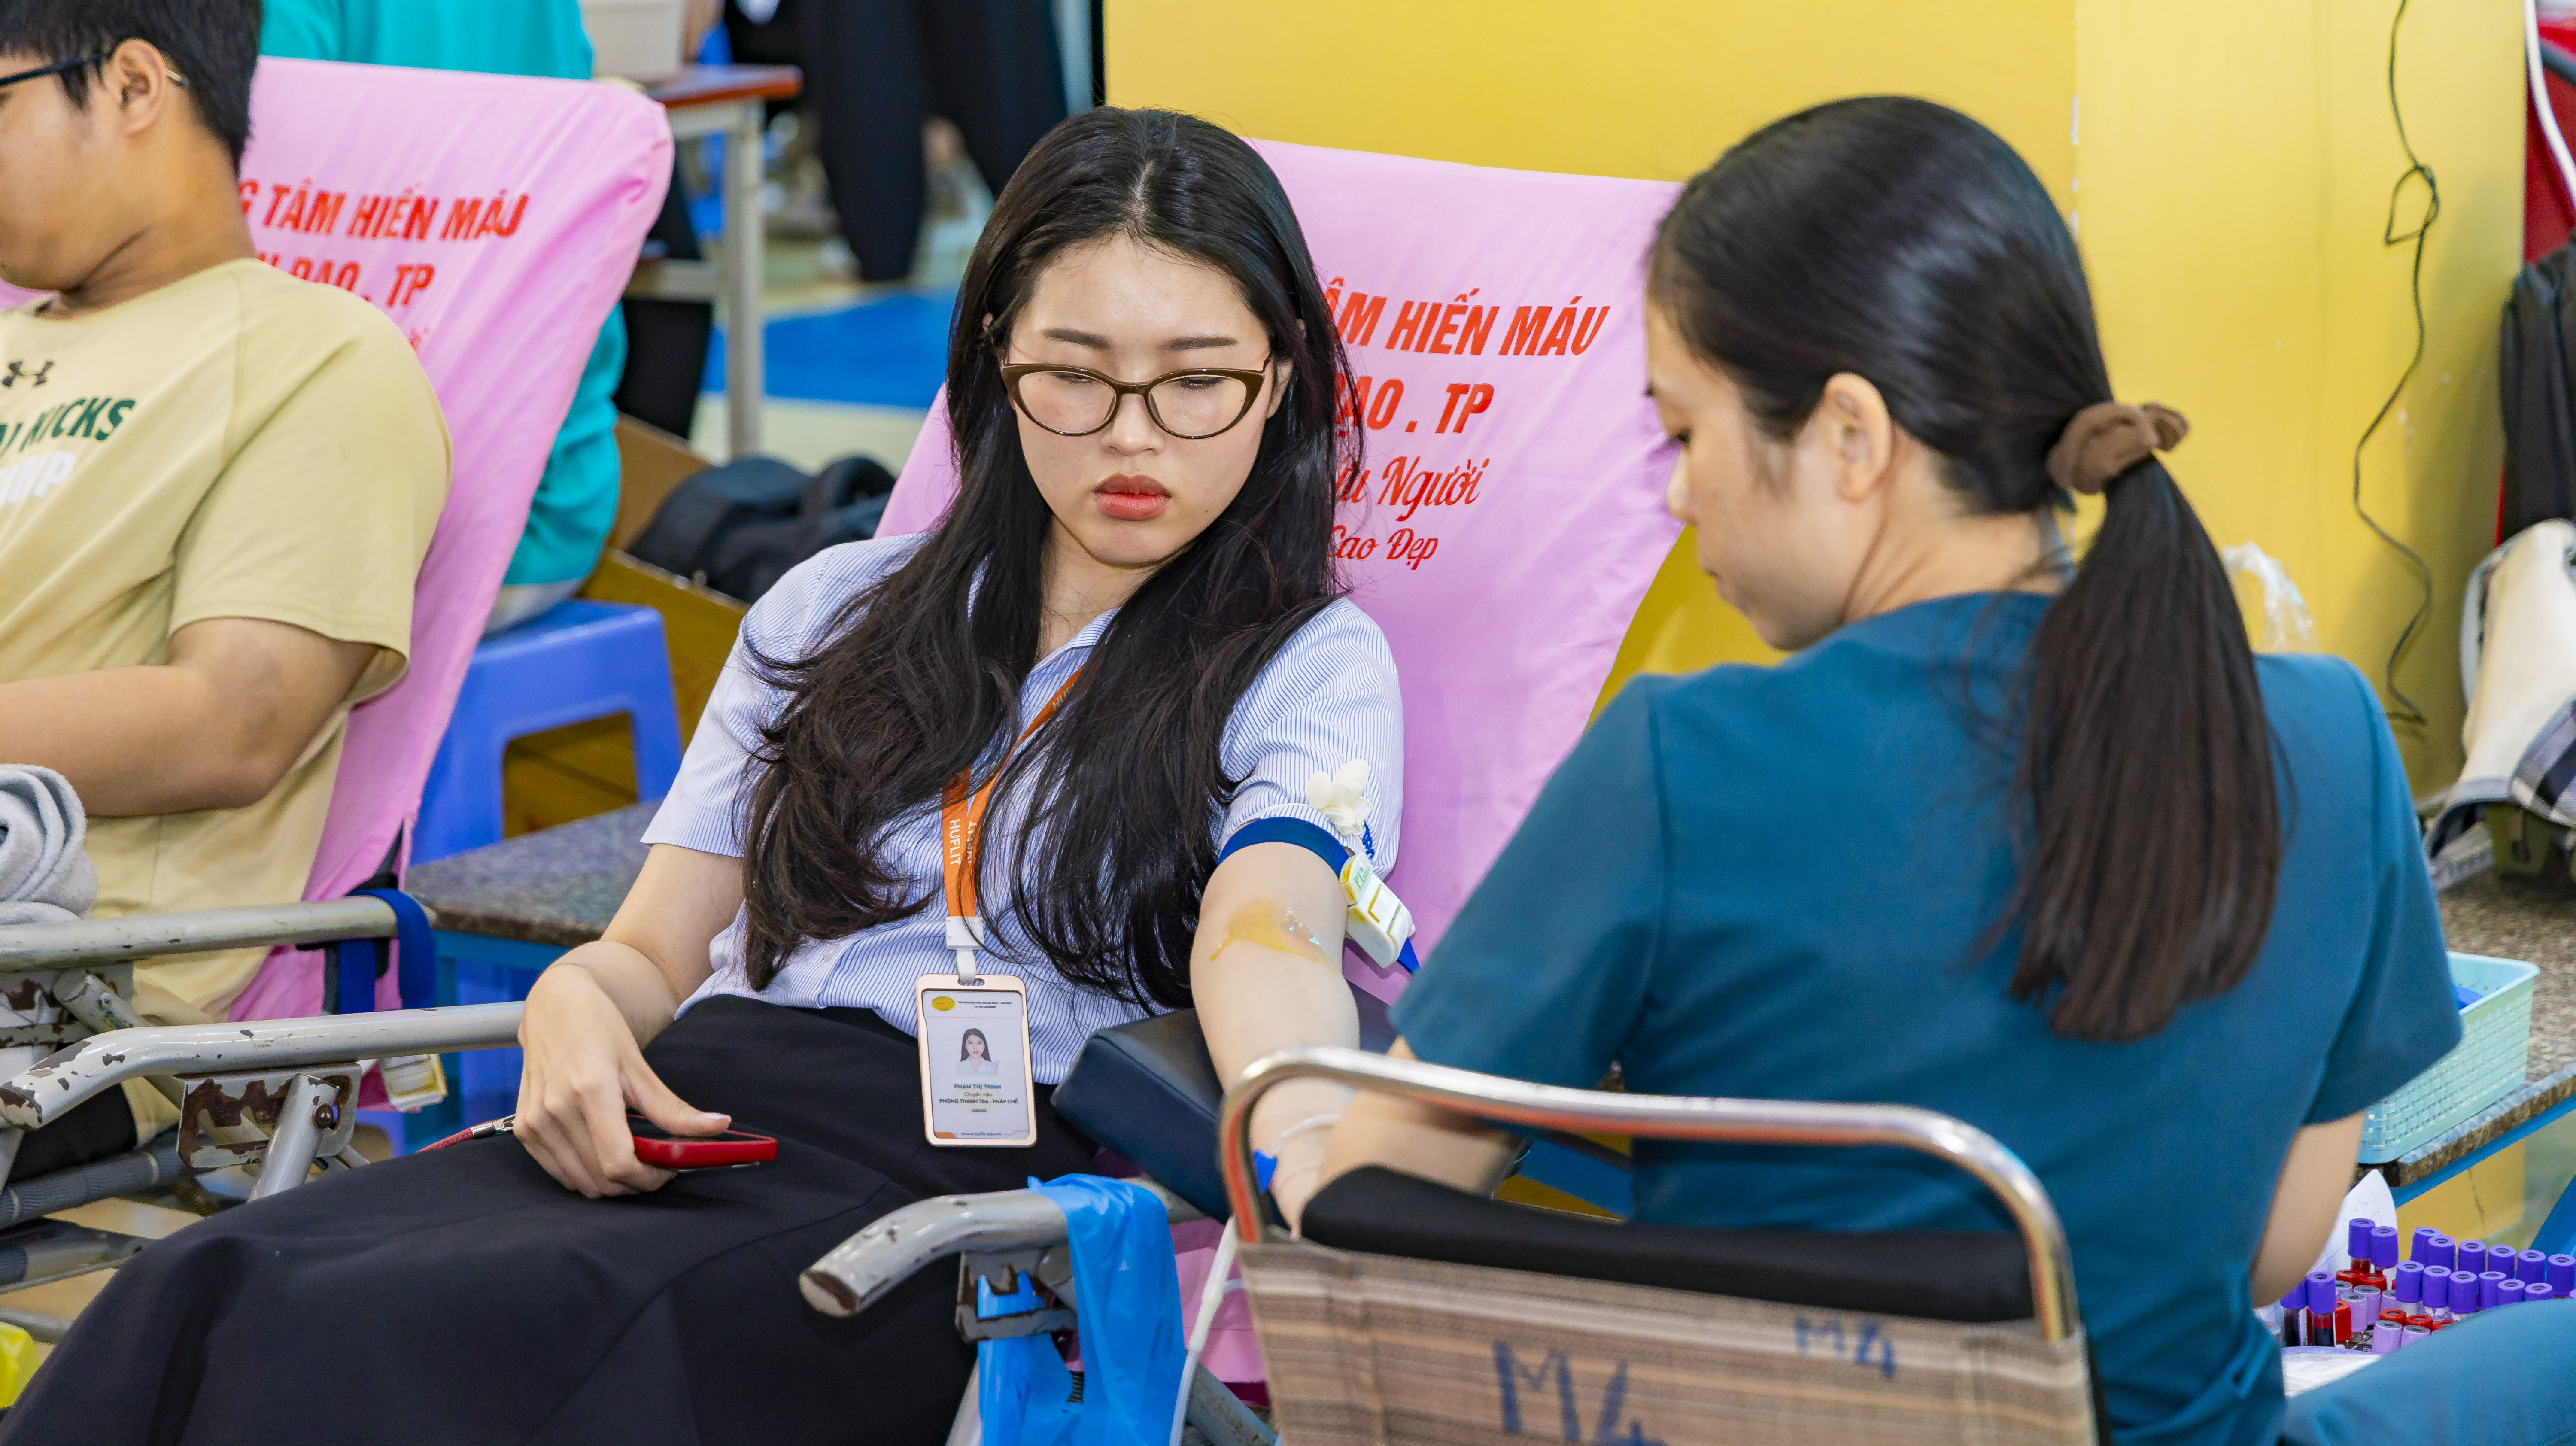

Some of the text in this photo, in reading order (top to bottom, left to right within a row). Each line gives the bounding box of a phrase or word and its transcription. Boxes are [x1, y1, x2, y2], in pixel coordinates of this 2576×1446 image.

[262, 178, 347, 235] TÂM
[345, 182, 440, 241] HIẾN
[439, 188, 529, 240] MÁU
[386, 263, 435, 308] TP
[1324, 276, 1610, 356] ÂM HIẾN MÁU
[1435, 383, 1495, 434] TP
[1376, 456, 1490, 523] Người
[1386, 528, 1439, 571] Đẹp
[949, 819, 961, 866] HUFLIT
[1794, 1317, 1897, 1379] M4
